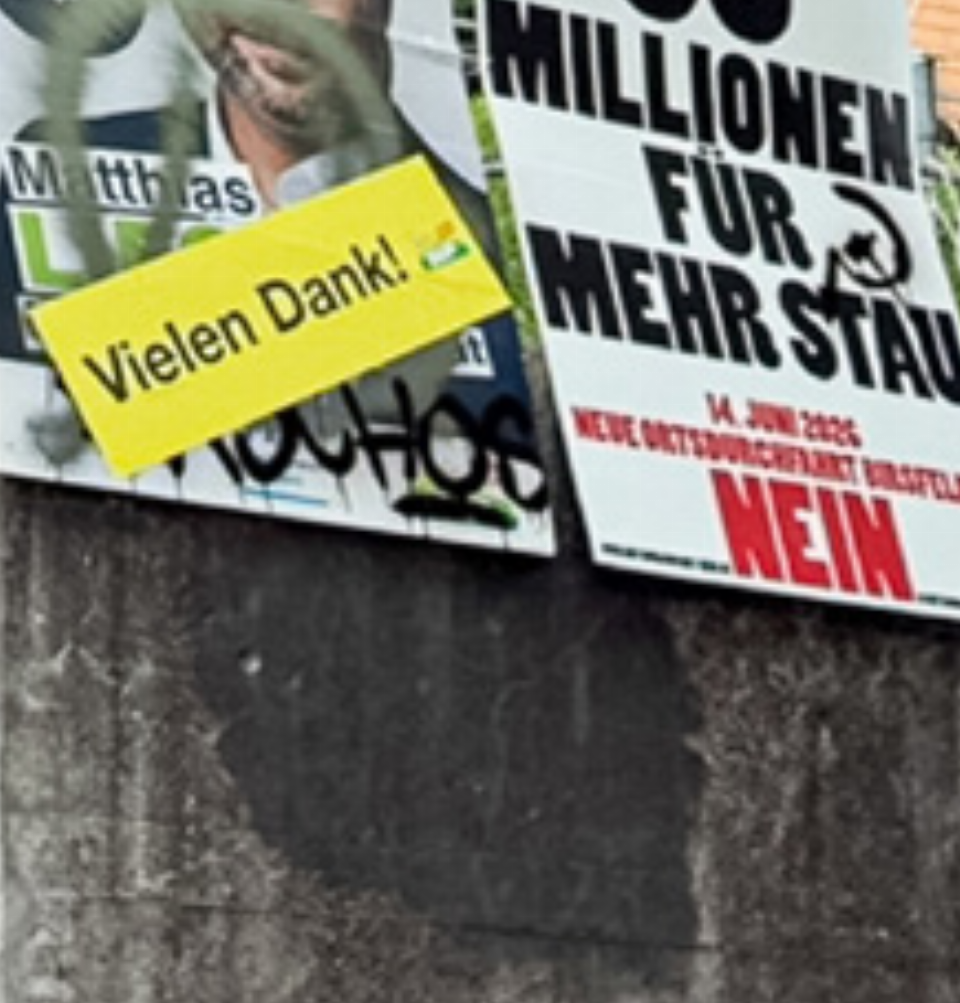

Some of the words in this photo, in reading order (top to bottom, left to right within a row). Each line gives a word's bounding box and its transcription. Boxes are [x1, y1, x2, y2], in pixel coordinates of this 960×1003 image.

[7, 147, 255, 216] Mtthas
[642, 143, 815, 271] FÜR
[82, 308, 259, 404] Vielen
[255, 235, 411, 334] Dank!
[525, 222, 782, 369] MEHR
[778, 280, 960, 407] STAU
[709, 468, 916, 603] NEIN
